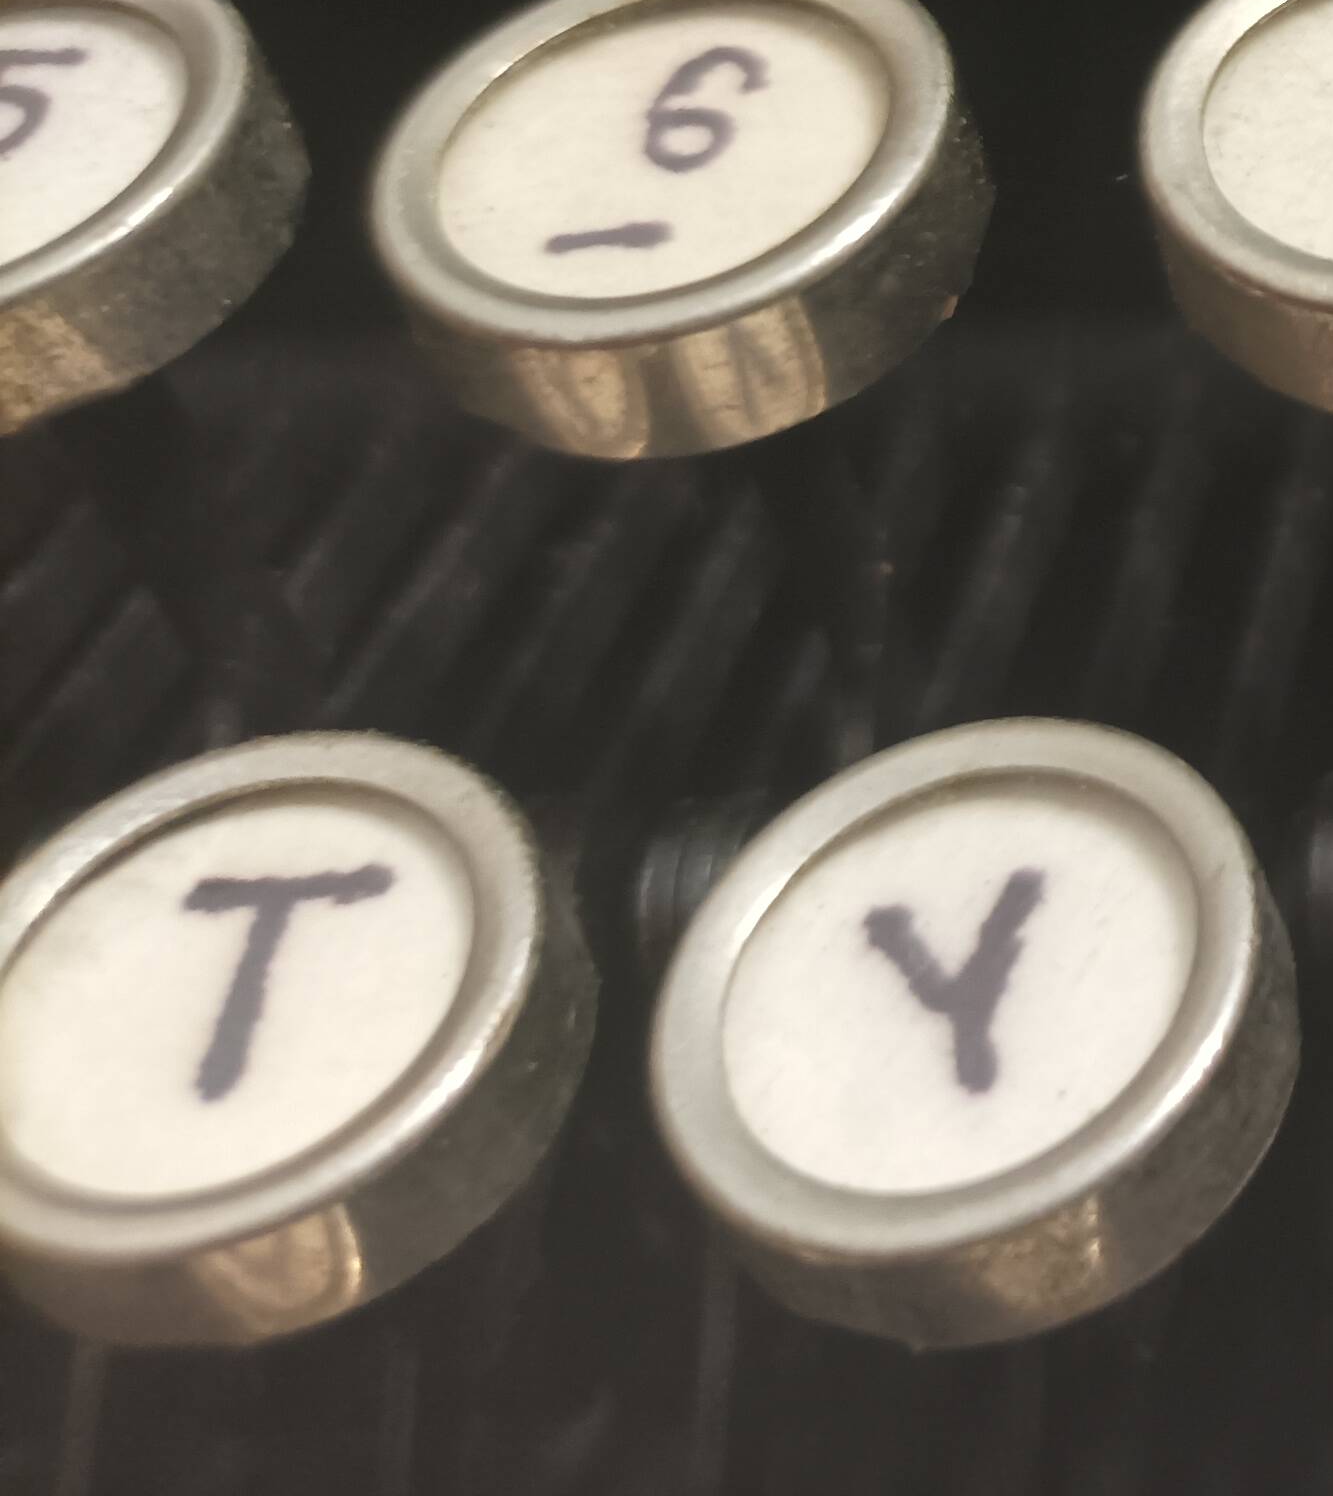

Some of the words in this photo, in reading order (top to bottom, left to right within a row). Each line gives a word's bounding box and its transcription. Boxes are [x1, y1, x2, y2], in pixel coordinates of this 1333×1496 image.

[642, 46, 766, 174] 6
[182, 862, 396, 1103] T
[862, 867, 1046, 1095] Y
